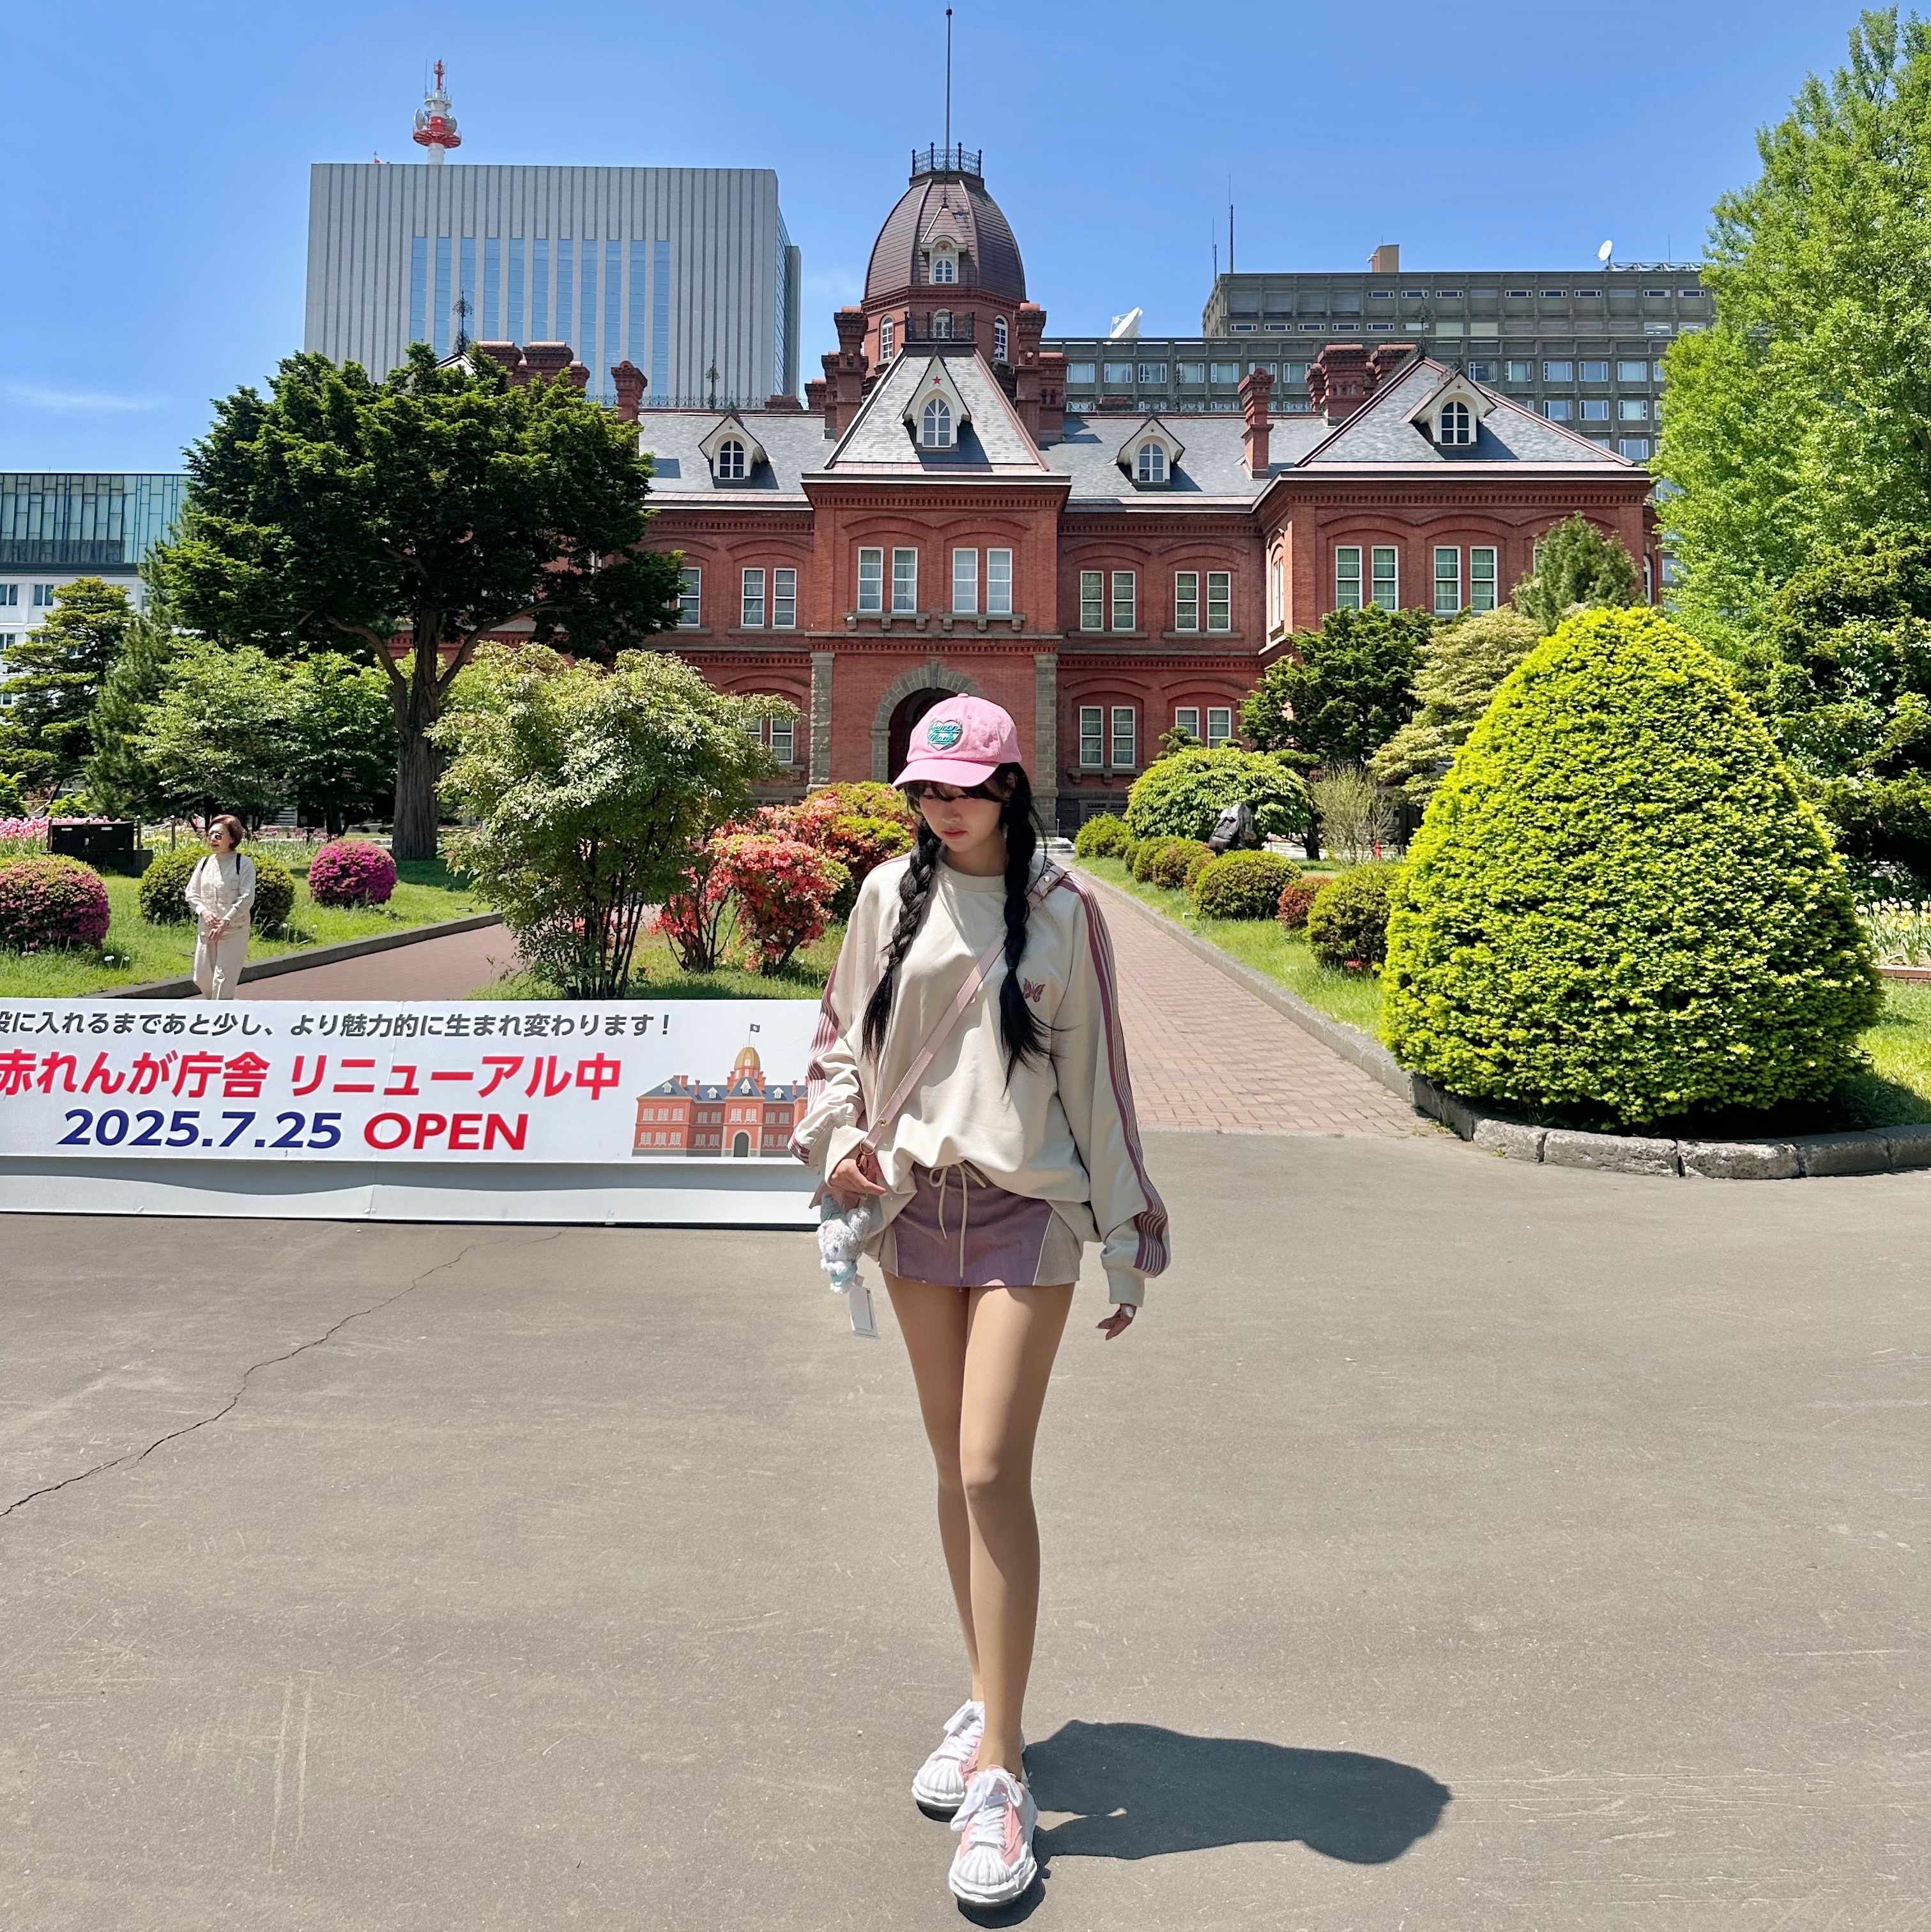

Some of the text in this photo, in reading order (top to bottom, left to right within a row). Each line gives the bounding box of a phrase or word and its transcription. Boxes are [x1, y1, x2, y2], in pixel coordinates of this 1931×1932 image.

[0, 1048, 622, 1100] 赤れんが庁舎 リニューアル中
[56, 1108, 529, 1150] 2025.7.25 OPEN
